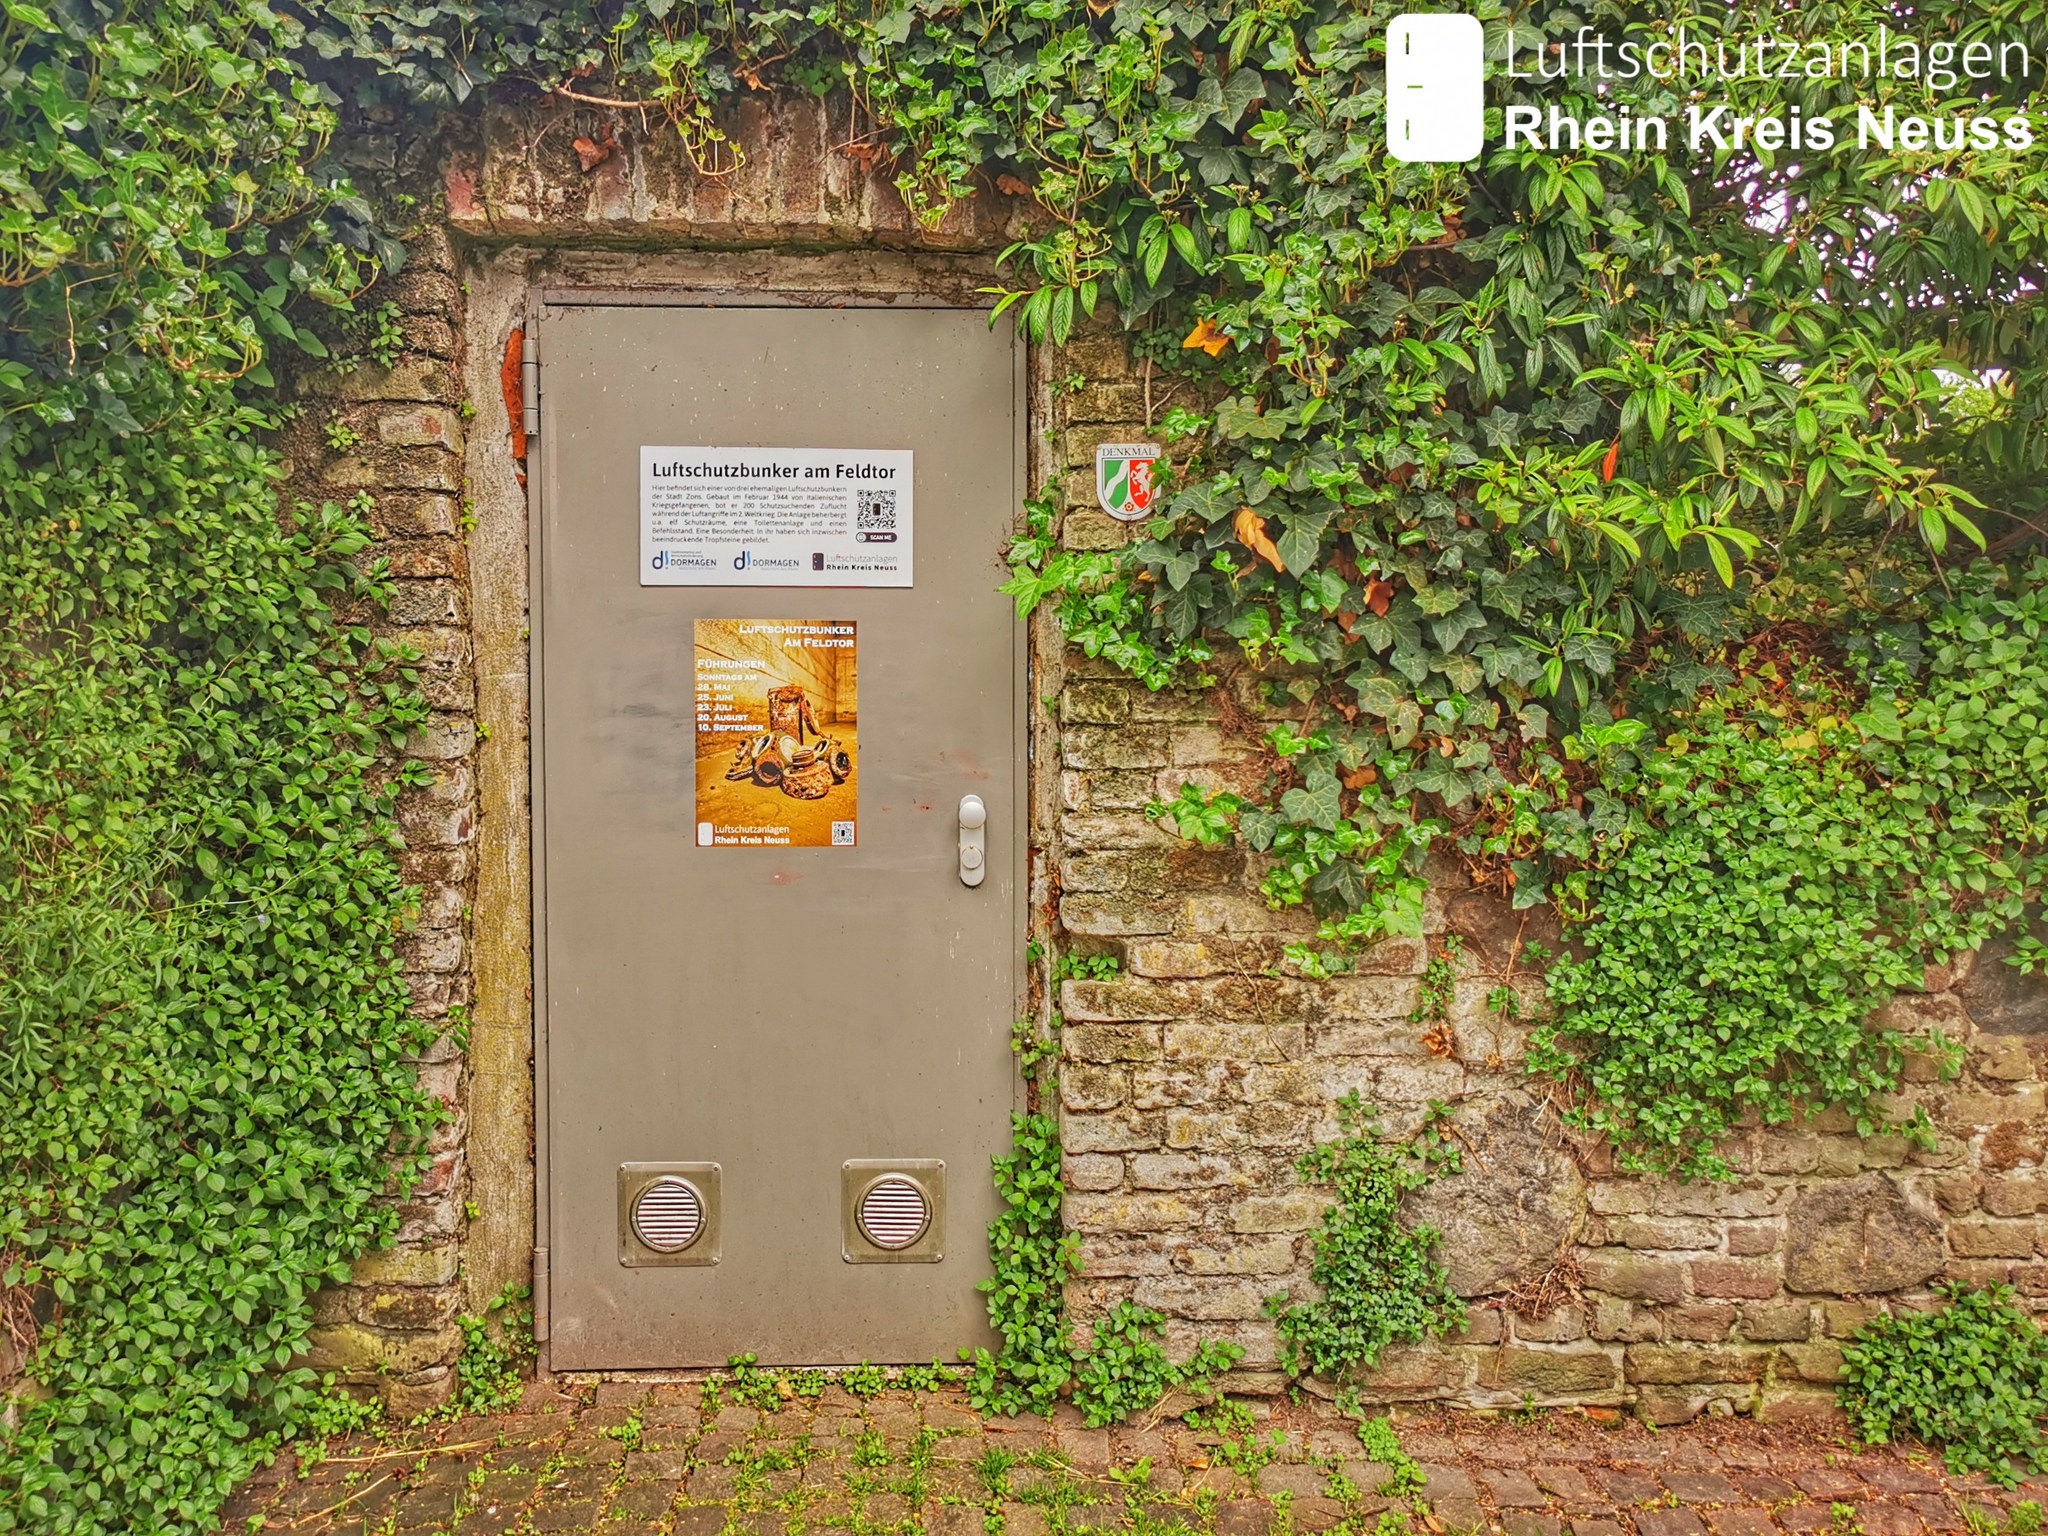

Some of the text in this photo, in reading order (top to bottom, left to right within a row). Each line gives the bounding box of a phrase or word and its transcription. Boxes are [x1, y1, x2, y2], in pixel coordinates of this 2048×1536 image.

[1102, 447, 1156, 457] DENKMAL
[653, 462, 896, 479] Luftschutzbunker am Feldtor
[826, 554, 898, 564] Luftschutzanlagen
[714, 824, 790, 835] Luftschutzanlagen
[714, 836, 790, 844] Rhein Kreis Neuss
